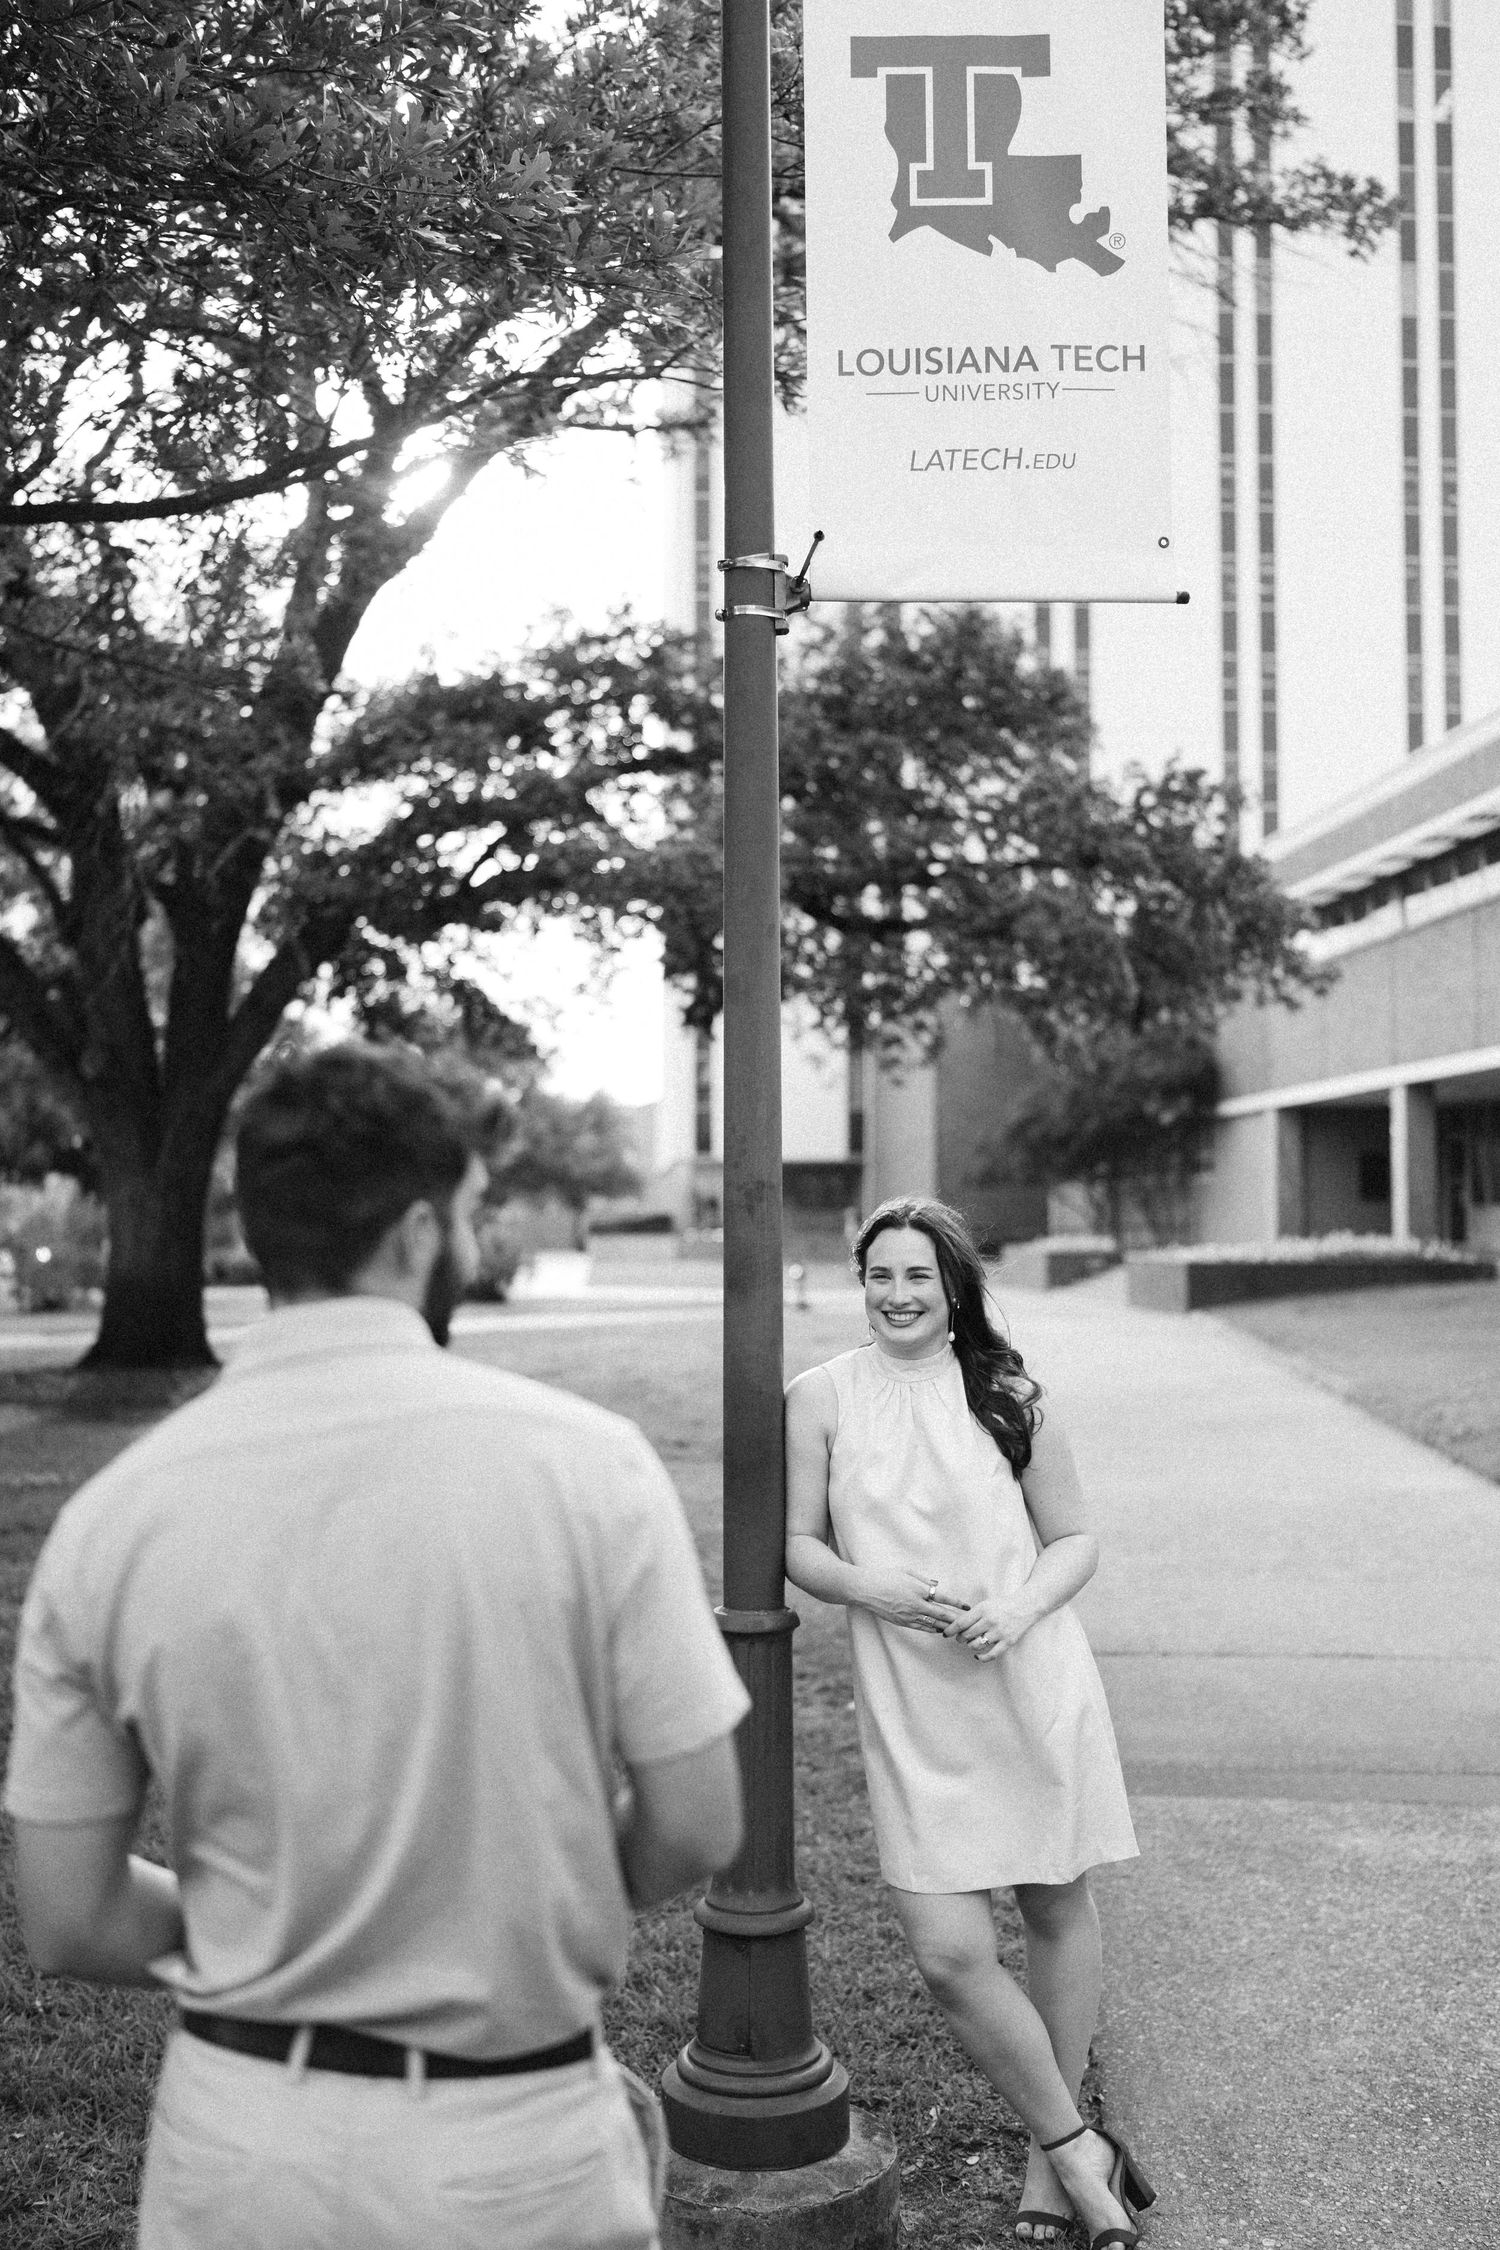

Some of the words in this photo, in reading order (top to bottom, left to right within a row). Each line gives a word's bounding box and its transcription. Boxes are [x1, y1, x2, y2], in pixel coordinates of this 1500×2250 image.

[837, 344, 1041, 378] LOUISIANA
[1050, 344, 1147, 374] TECH
[925, 381, 1061, 404] UNIVERSITY
[910, 447, 1078, 473] LATECH.EDU
